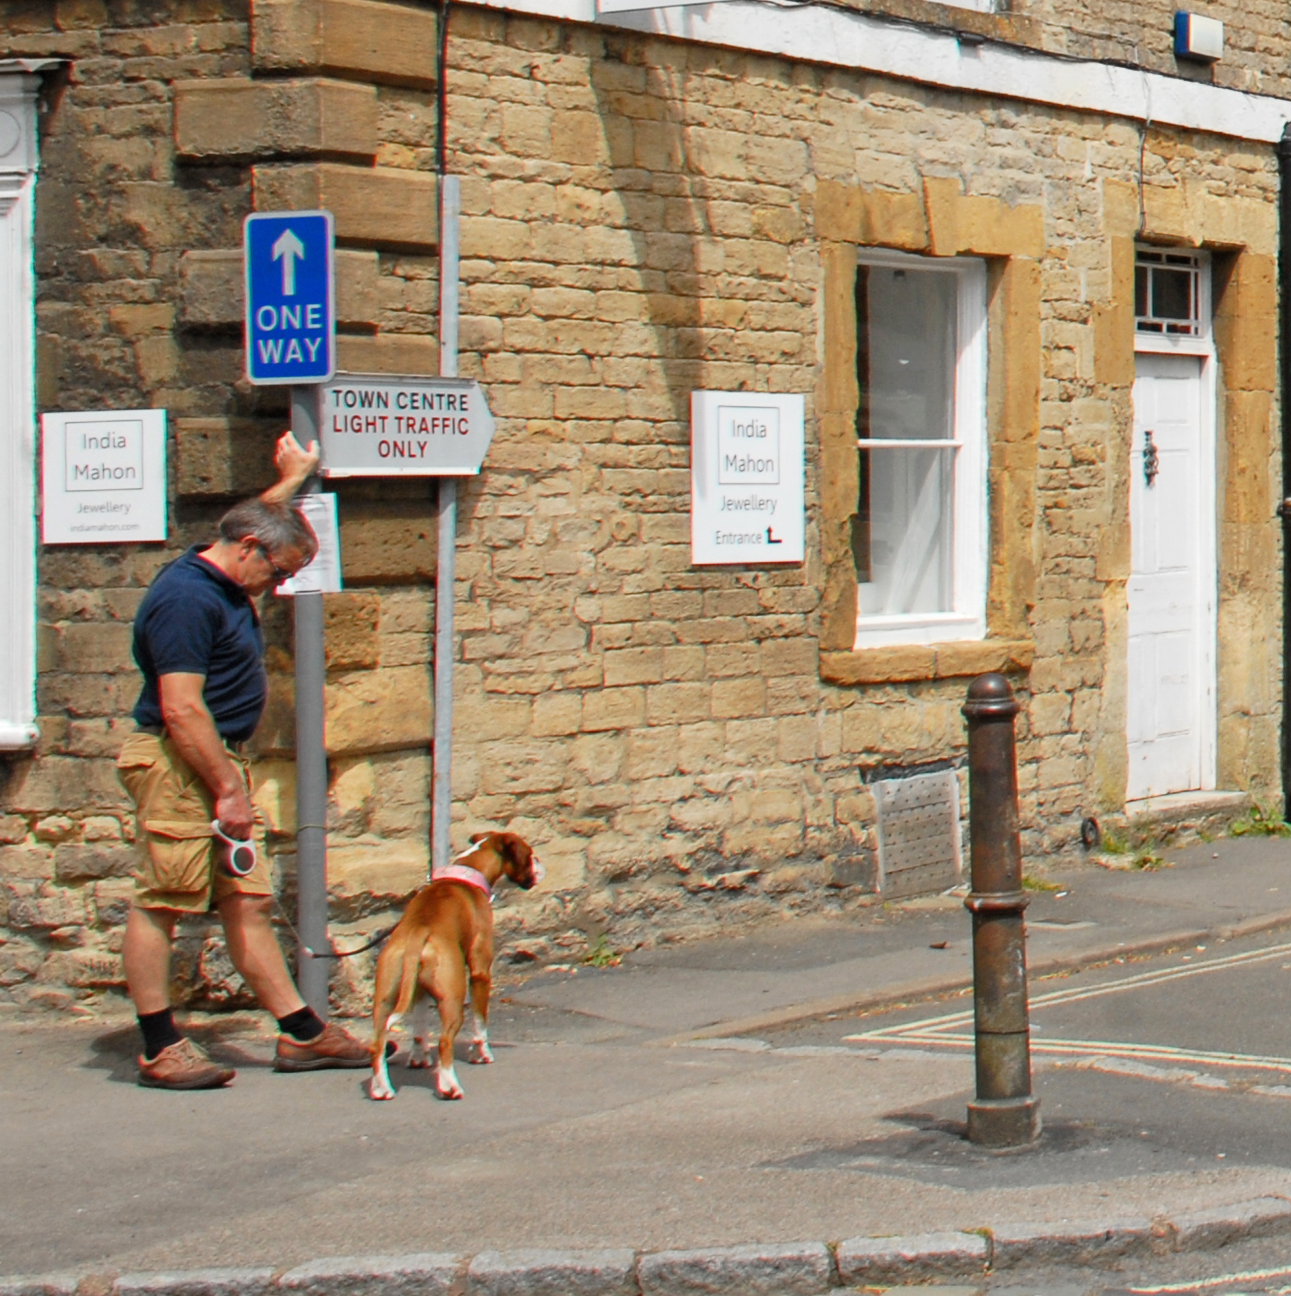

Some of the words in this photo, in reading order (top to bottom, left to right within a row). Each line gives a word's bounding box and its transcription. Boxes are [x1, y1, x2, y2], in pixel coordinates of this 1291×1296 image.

[256, 303, 323, 331] ONE
[257, 337, 322, 364] WAY
[332, 389, 389, 409] TOWN
[396, 391, 469, 411] CENTRE
[332, 414, 389, 434] LIGHT
[394, 415, 470, 435] TRAFFIC
[732, 419, 767, 438] India
[83, 432, 127, 449] India
[378, 440, 428, 458] ONLY
[74, 463, 136, 480] Mahon
[725, 454, 774, 473] Mahon
[77, 502, 132, 515] Jewellery
[720, 495, 778, 515] Jewellery
[70, 522, 140, 533] indiamahon.com
[716, 530, 763, 545] Entrance
